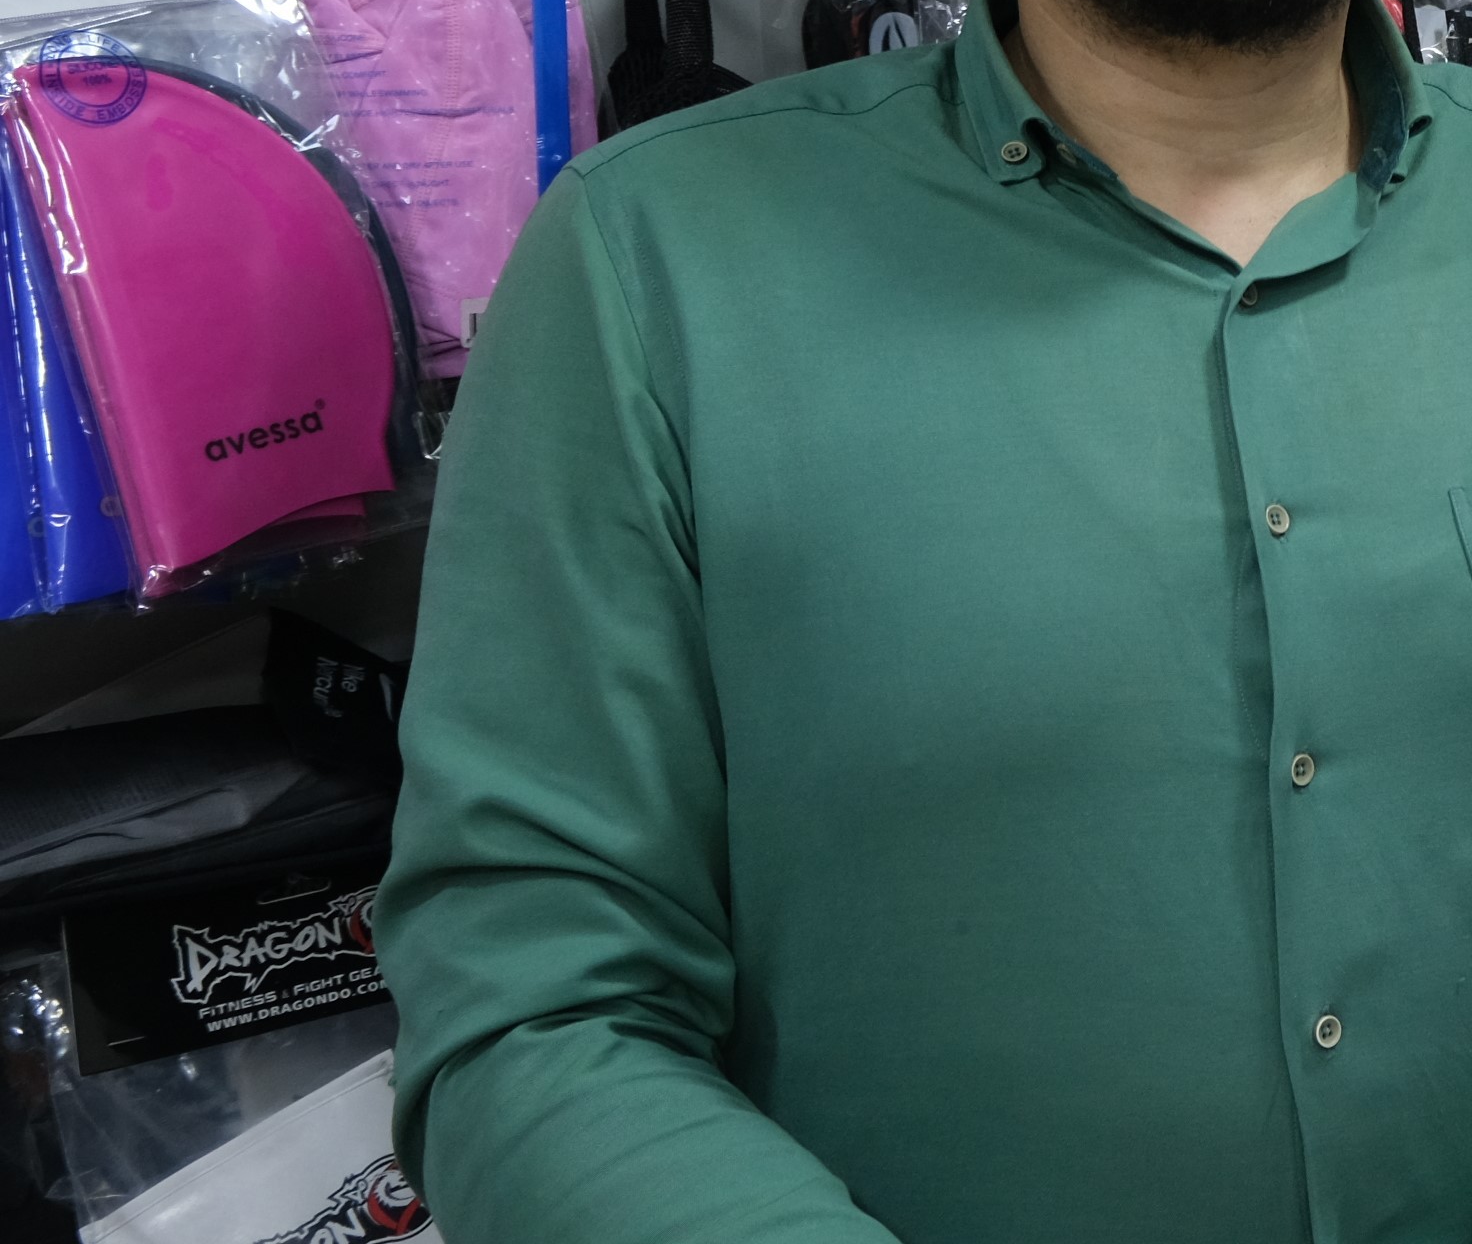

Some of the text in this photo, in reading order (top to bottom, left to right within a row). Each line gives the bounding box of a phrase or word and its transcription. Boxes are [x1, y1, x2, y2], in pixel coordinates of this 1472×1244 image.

[88, 35, 120, 53] LIFE
[186, 917, 343, 993] DRAGON
[349, 967, 381, 983] GEA
